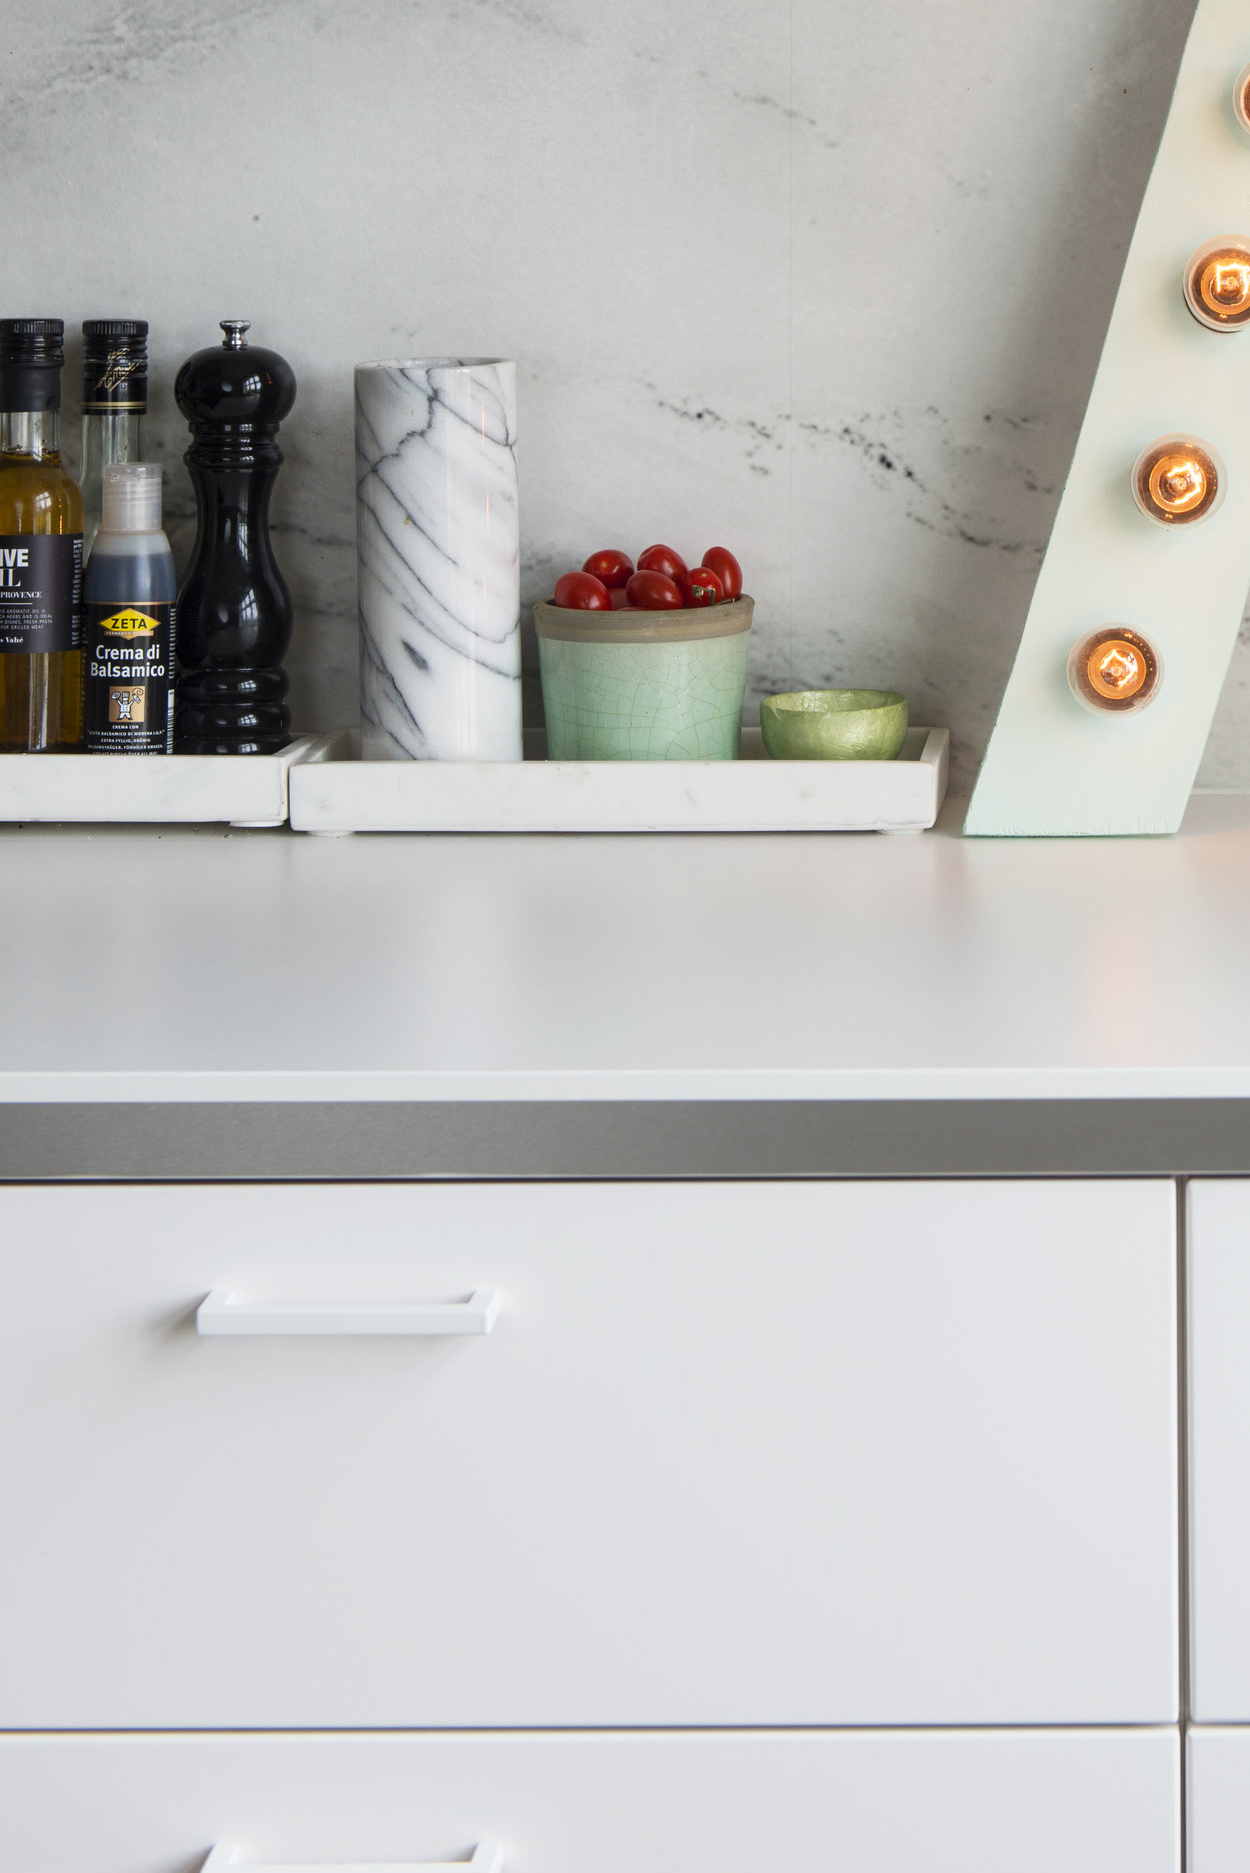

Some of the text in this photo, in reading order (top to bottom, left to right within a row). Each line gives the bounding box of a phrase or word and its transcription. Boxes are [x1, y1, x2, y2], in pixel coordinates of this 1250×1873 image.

[111, 618, 147, 629] ZETA
[96, 643, 160, 660] Crema di
[90, 661, 165, 678] Balsamico
